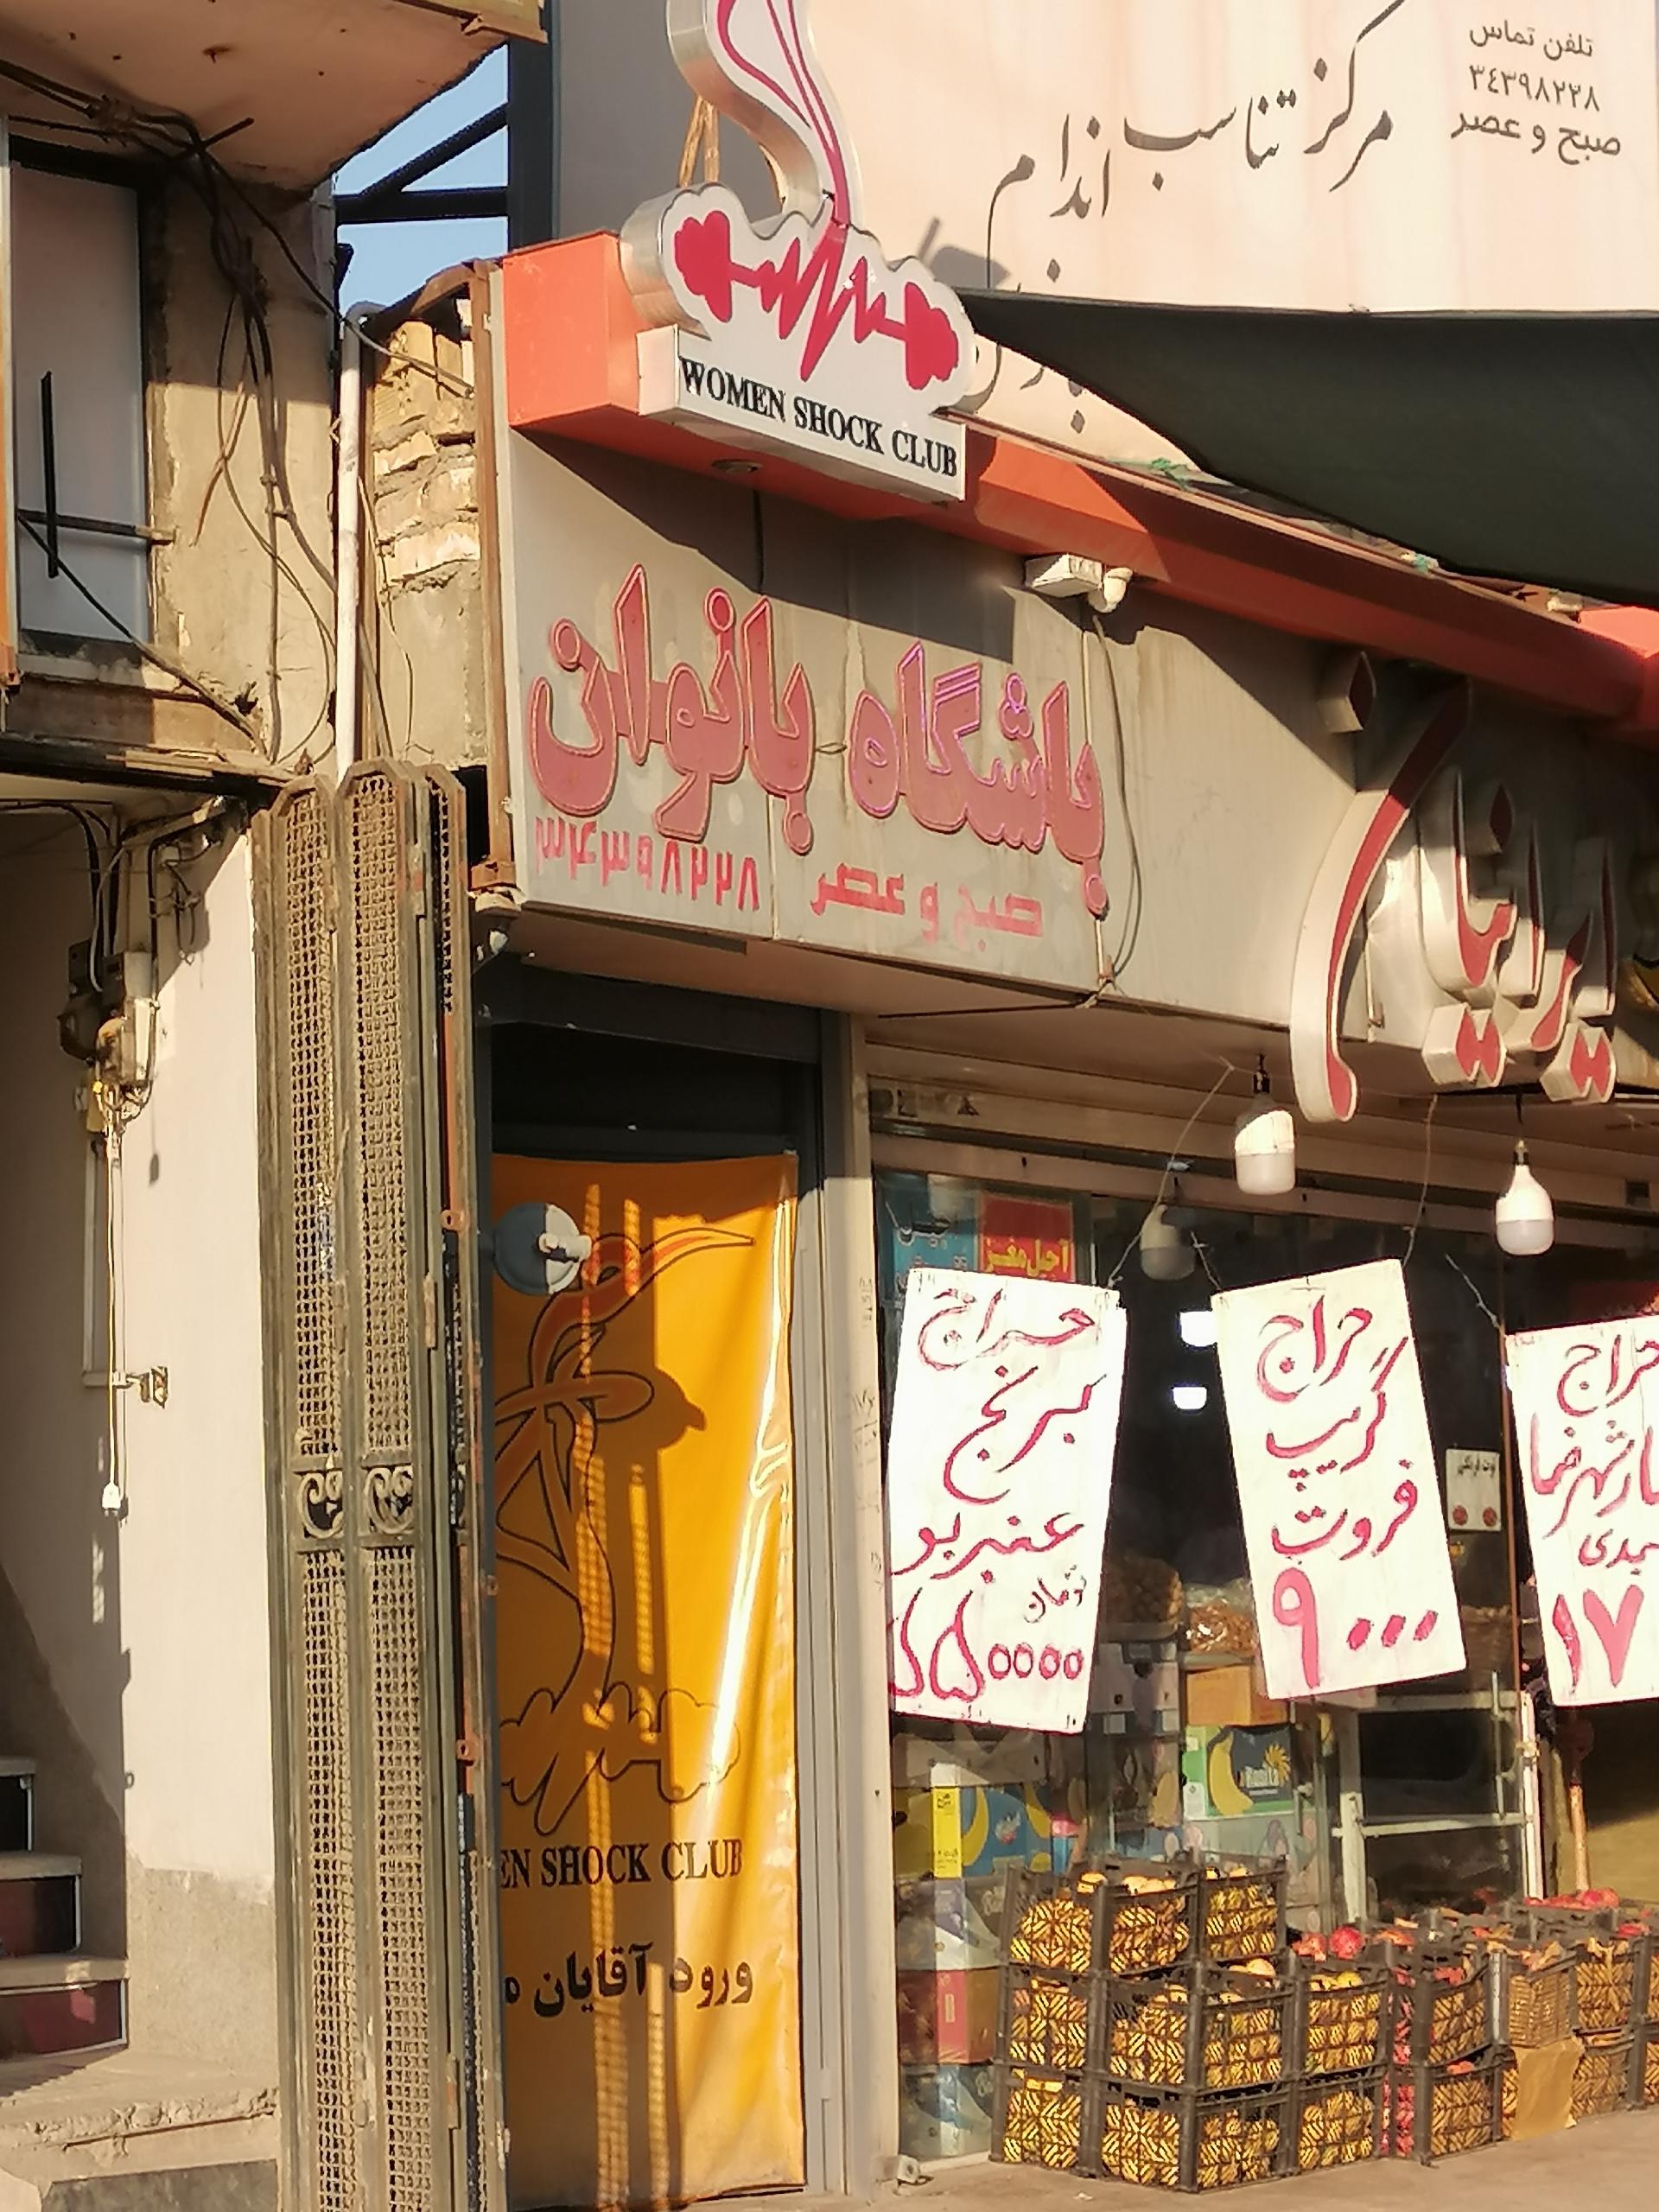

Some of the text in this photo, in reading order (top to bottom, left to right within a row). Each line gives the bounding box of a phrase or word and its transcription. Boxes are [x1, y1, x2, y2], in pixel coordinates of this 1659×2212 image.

[1469, 19, 1593, 60] تلفن تماس
[987, 0, 1405, 289] مرکز تناسب اندام
[1451, 112, 1621, 166] صبح و عصر
[680, 355, 958, 478] WOMEN SHOCK CLUB
[527, 563, 1108, 919] باشگاه بانوان
[810, 862, 906, 916] عصر
[918, 1287, 1096, 1371] حراج
[1256, 1294, 1374, 1403] حراج
[943, 1363, 1108, 1506] برنج
[1270, 1458, 1418, 1560] فروت
[540, 1842, 652, 1887] SHOCK
[661, 1838, 744, 1882] CLUB
[533, 1941, 654, 2018] آقایان
